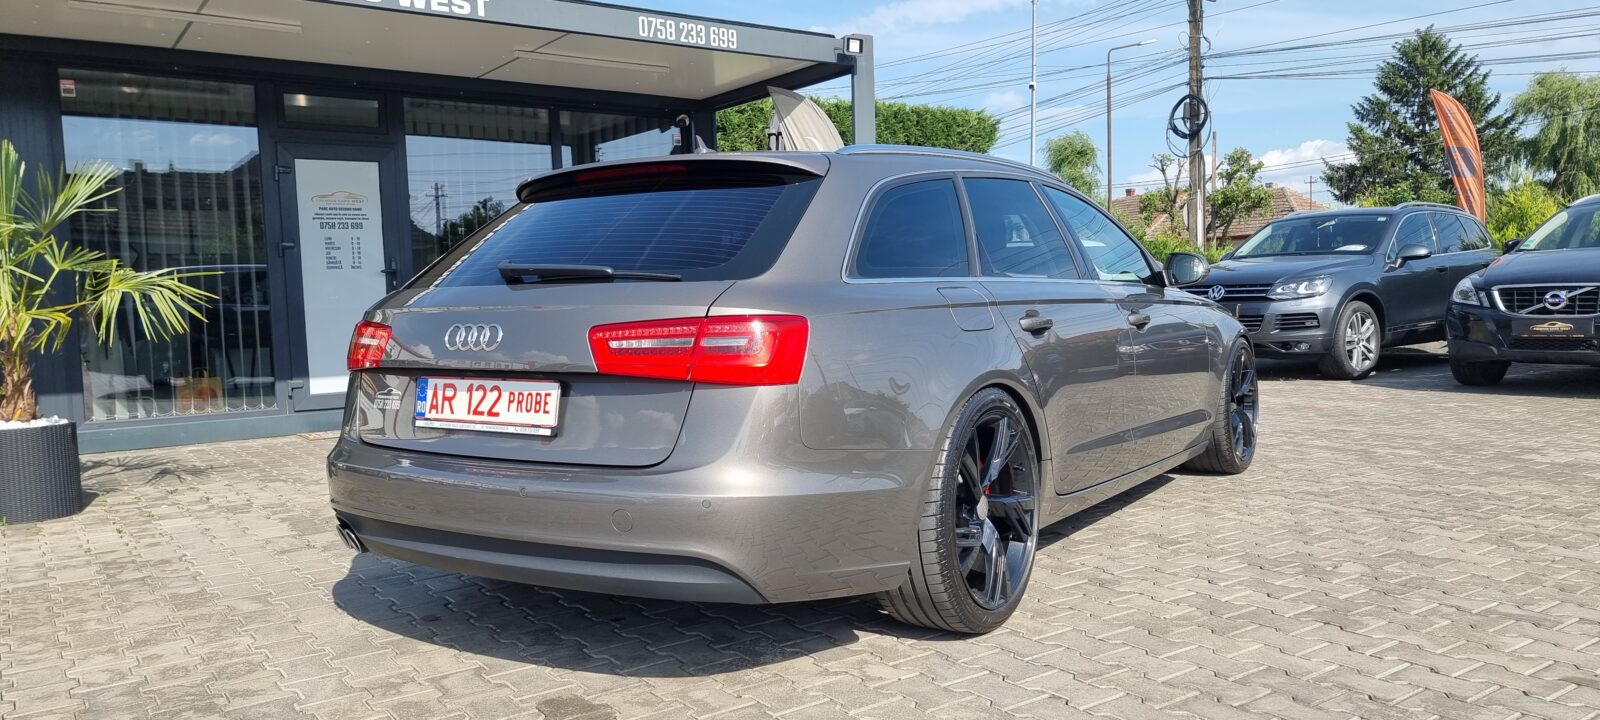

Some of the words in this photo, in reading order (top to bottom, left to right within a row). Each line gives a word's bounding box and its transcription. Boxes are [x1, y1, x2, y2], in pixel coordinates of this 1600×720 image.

[638, 16, 676, 41] 0758
[679, 22, 706, 45] 233
[710, 26, 737, 49] 699
[319, 222, 336, 230] 0758
[337, 222, 350, 230] 233
[350, 222, 364, 230] 699
[416, 400, 426, 413] RO
[428, 383, 458, 415] AR
[466, 383, 503, 417] 122
[507, 391, 552, 414] PROBE
